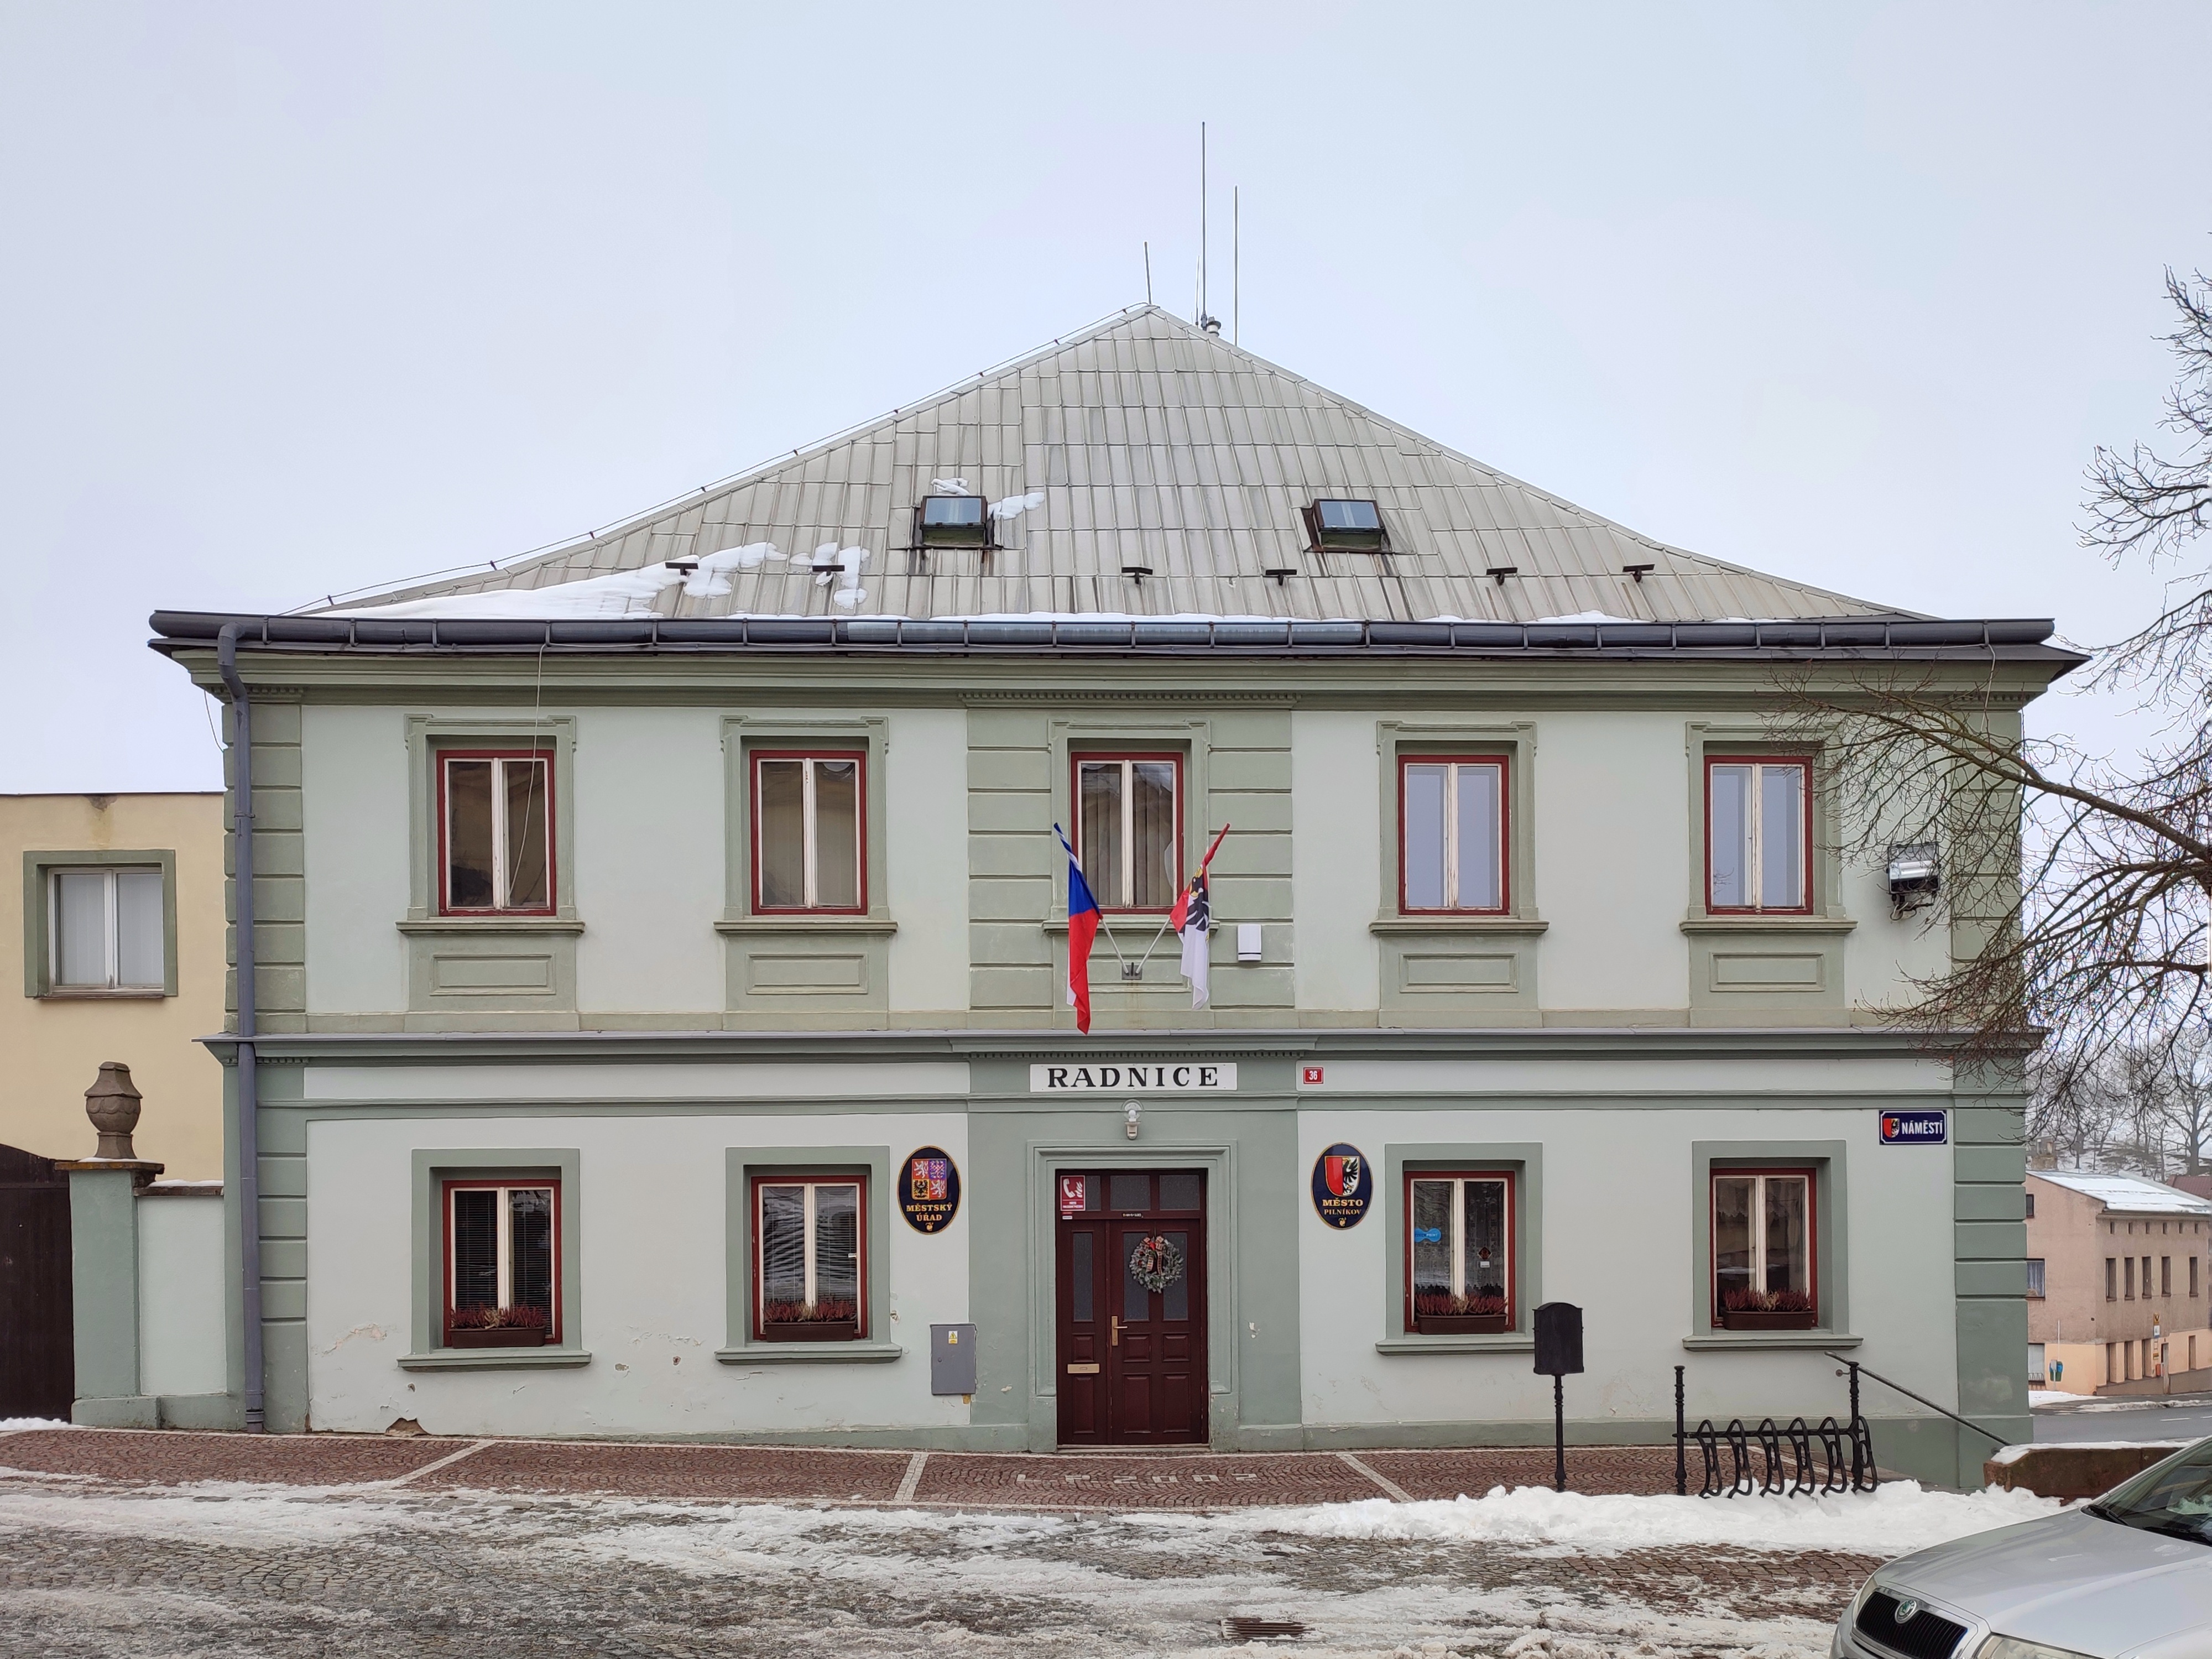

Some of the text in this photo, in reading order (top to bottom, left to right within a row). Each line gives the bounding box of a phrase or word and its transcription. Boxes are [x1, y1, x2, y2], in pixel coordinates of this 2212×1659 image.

[1047, 1066, 1218, 1087] RADNICE
[1309, 1070, 1318, 1080] 36
[1901, 1120, 1943, 1135] NÁMĚSTÍ
[906, 1202, 953, 1212] MĚSTSKÝ
[1322, 1197, 1364, 1207] MĚSTO
[916, 1212, 943, 1222] ÚŘAD
